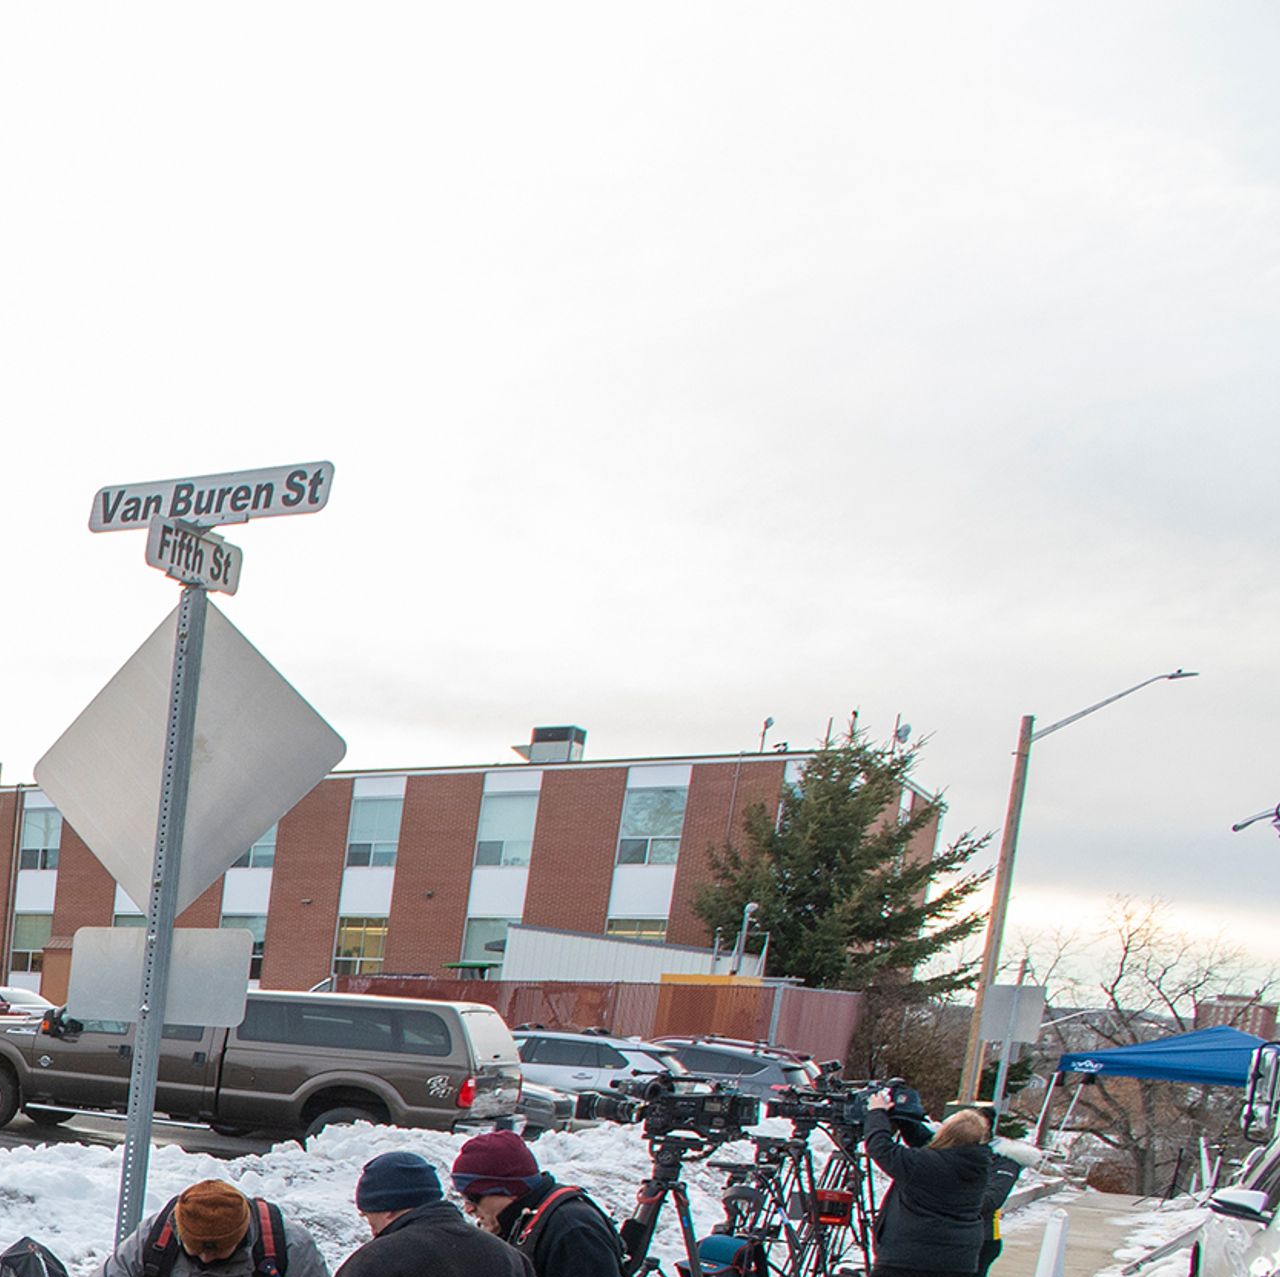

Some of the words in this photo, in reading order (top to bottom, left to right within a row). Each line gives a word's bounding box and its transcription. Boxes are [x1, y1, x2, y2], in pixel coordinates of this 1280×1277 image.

[101, 489, 162, 524] Van
[168, 482, 274, 518] Buren
[281, 467, 324, 507] St
[158, 525, 204, 575] Fifth
[209, 543, 232, 585] St
